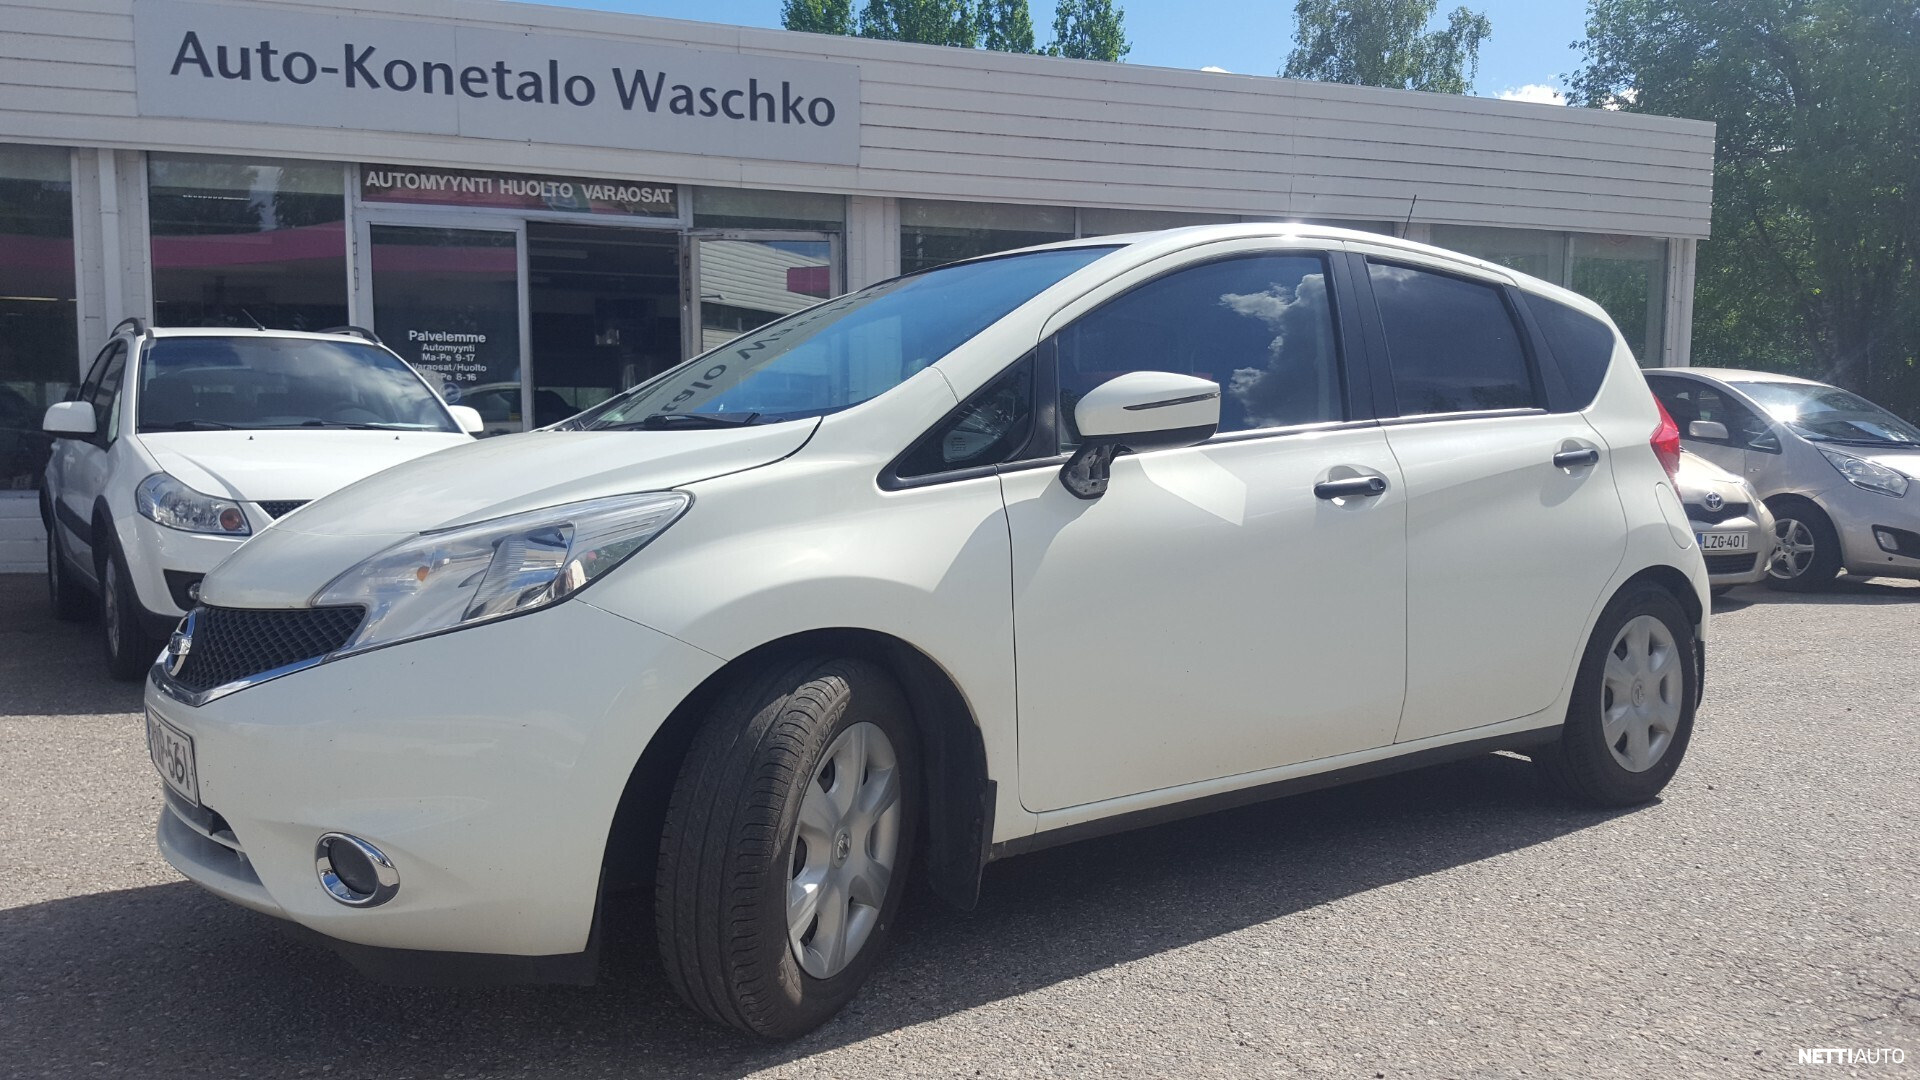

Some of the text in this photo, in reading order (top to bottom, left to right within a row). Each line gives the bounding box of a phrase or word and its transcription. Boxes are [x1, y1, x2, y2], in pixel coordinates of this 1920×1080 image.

[170, 31, 836, 127] Auto-Konetalo Waschko
[366, 171, 673, 204] AUTOMYYNTI HUOLTO VARAOSAT
[409, 330, 487, 343] Palvelemme
[422, 343, 476, 353] Automyynti
[422, 353, 475, 362] Ma-Pe 9-17
[412, 363, 487, 372] Varaosat/Huolto
[1704, 535, 1745, 549] LZG-401
